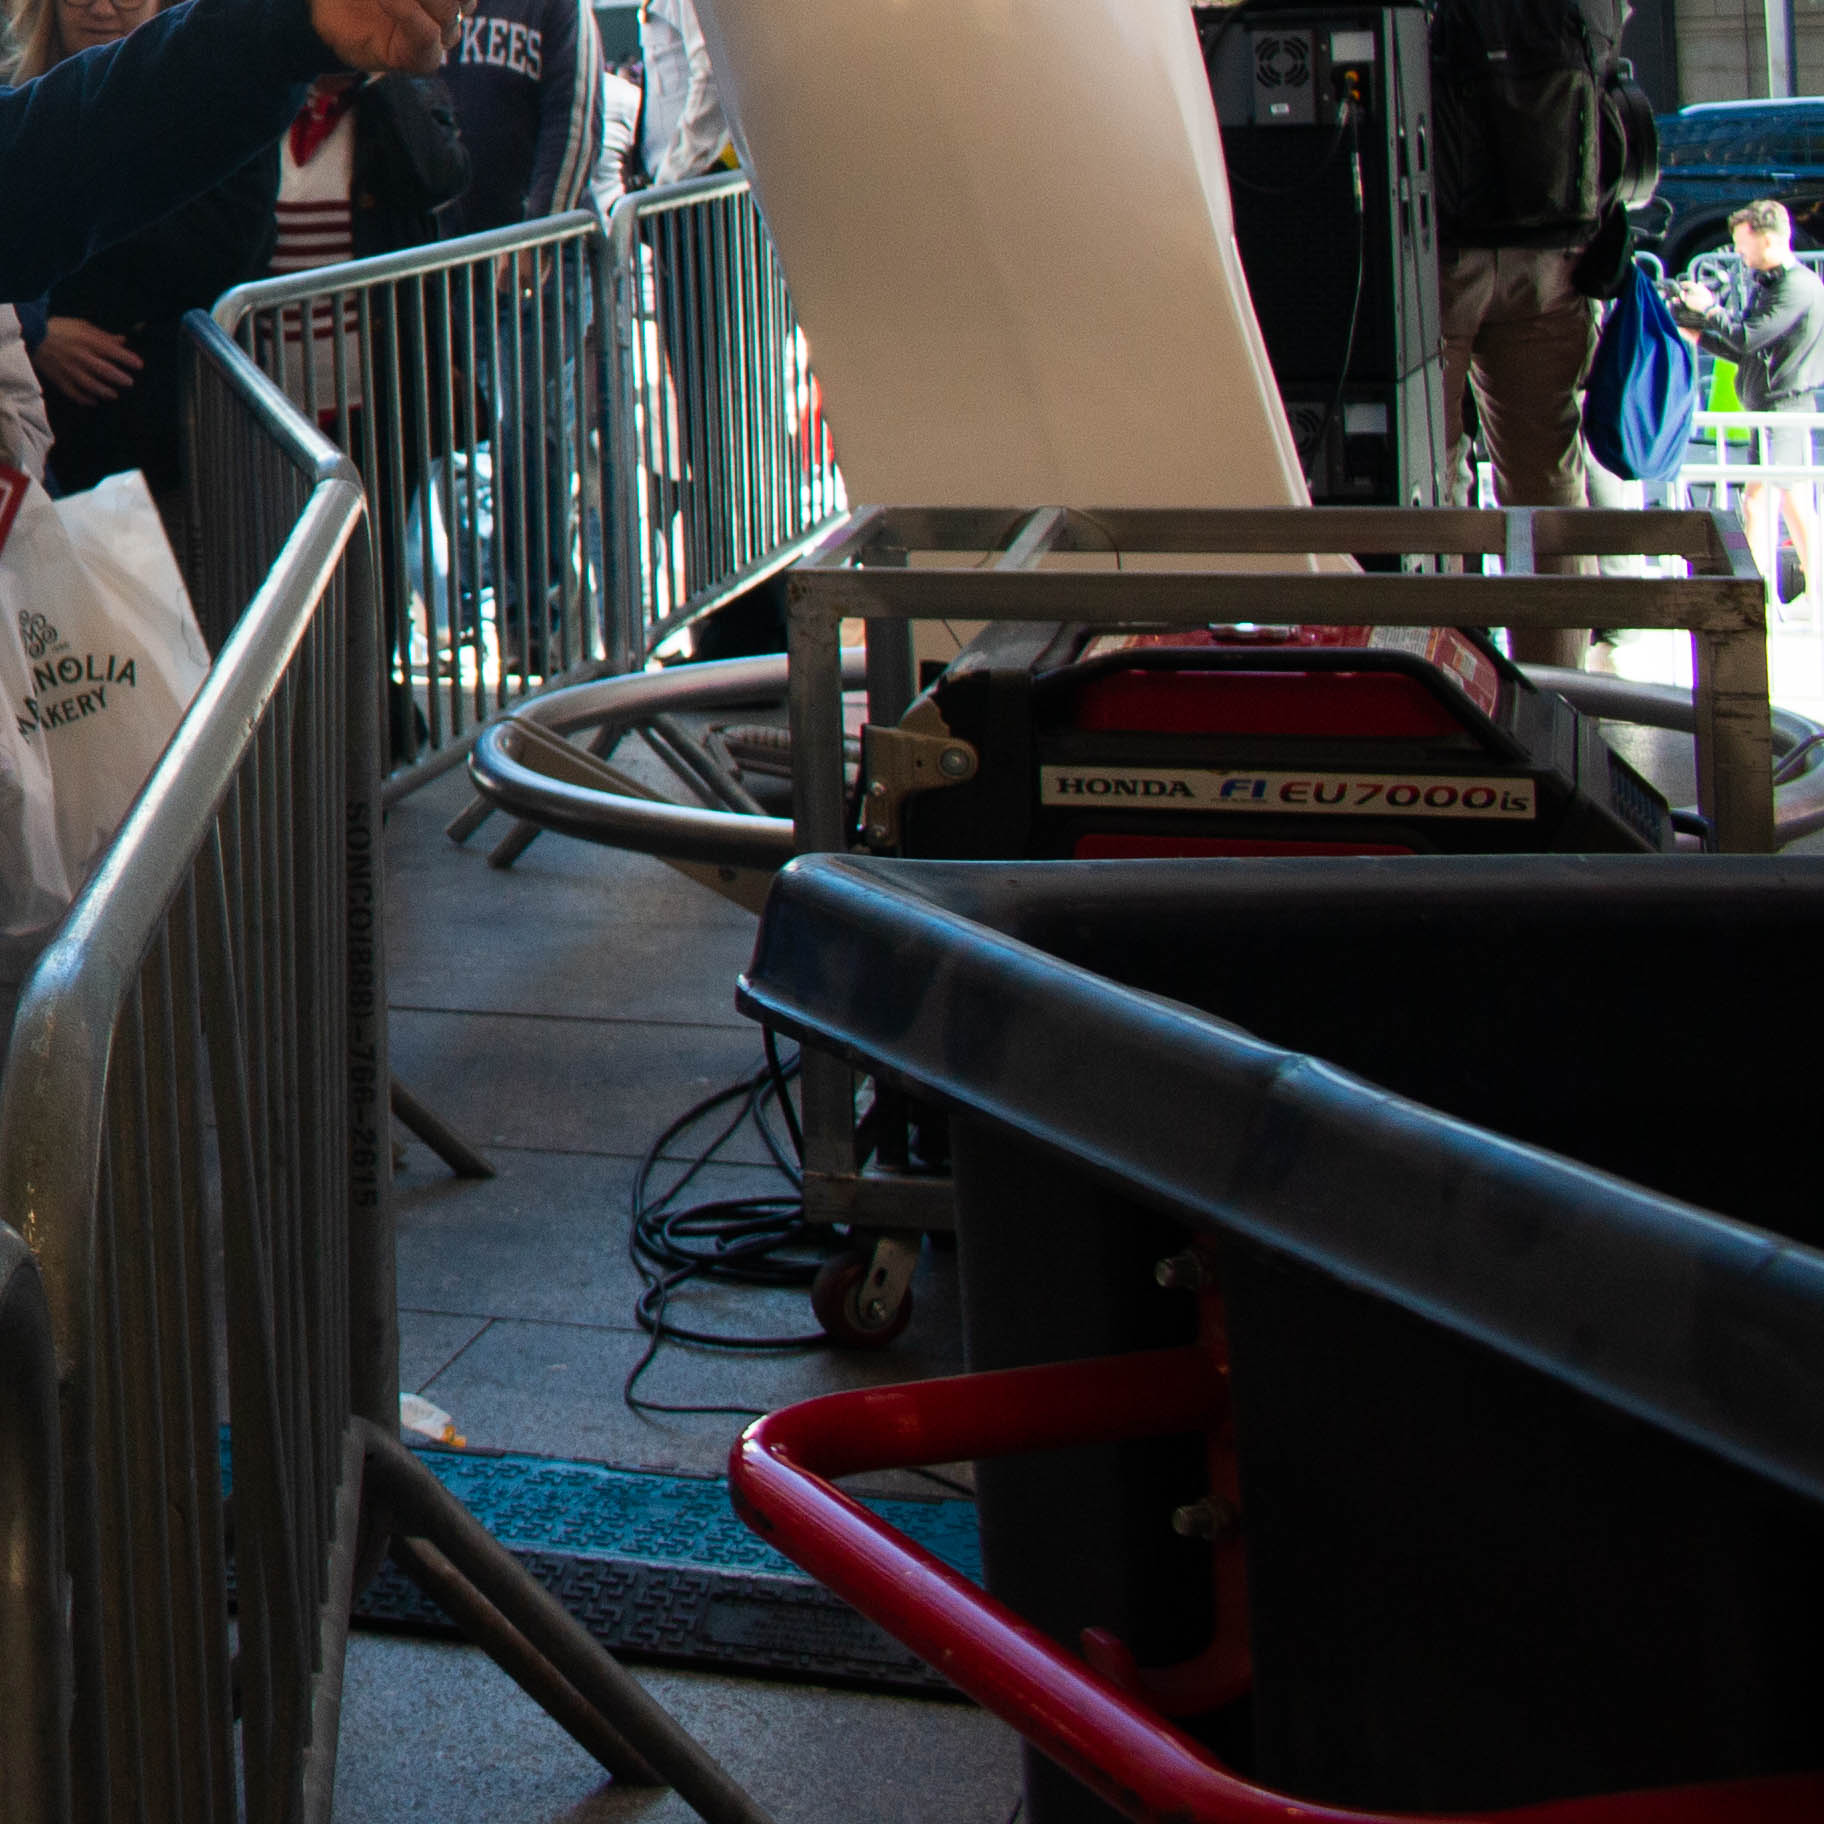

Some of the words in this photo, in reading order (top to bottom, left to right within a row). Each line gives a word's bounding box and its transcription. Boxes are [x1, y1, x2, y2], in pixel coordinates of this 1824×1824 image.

[440, 16, 543, 81] KEES
[1055, 776, 1195, 799] HONDA
[1278, 780, 1529, 813] EU7000is
